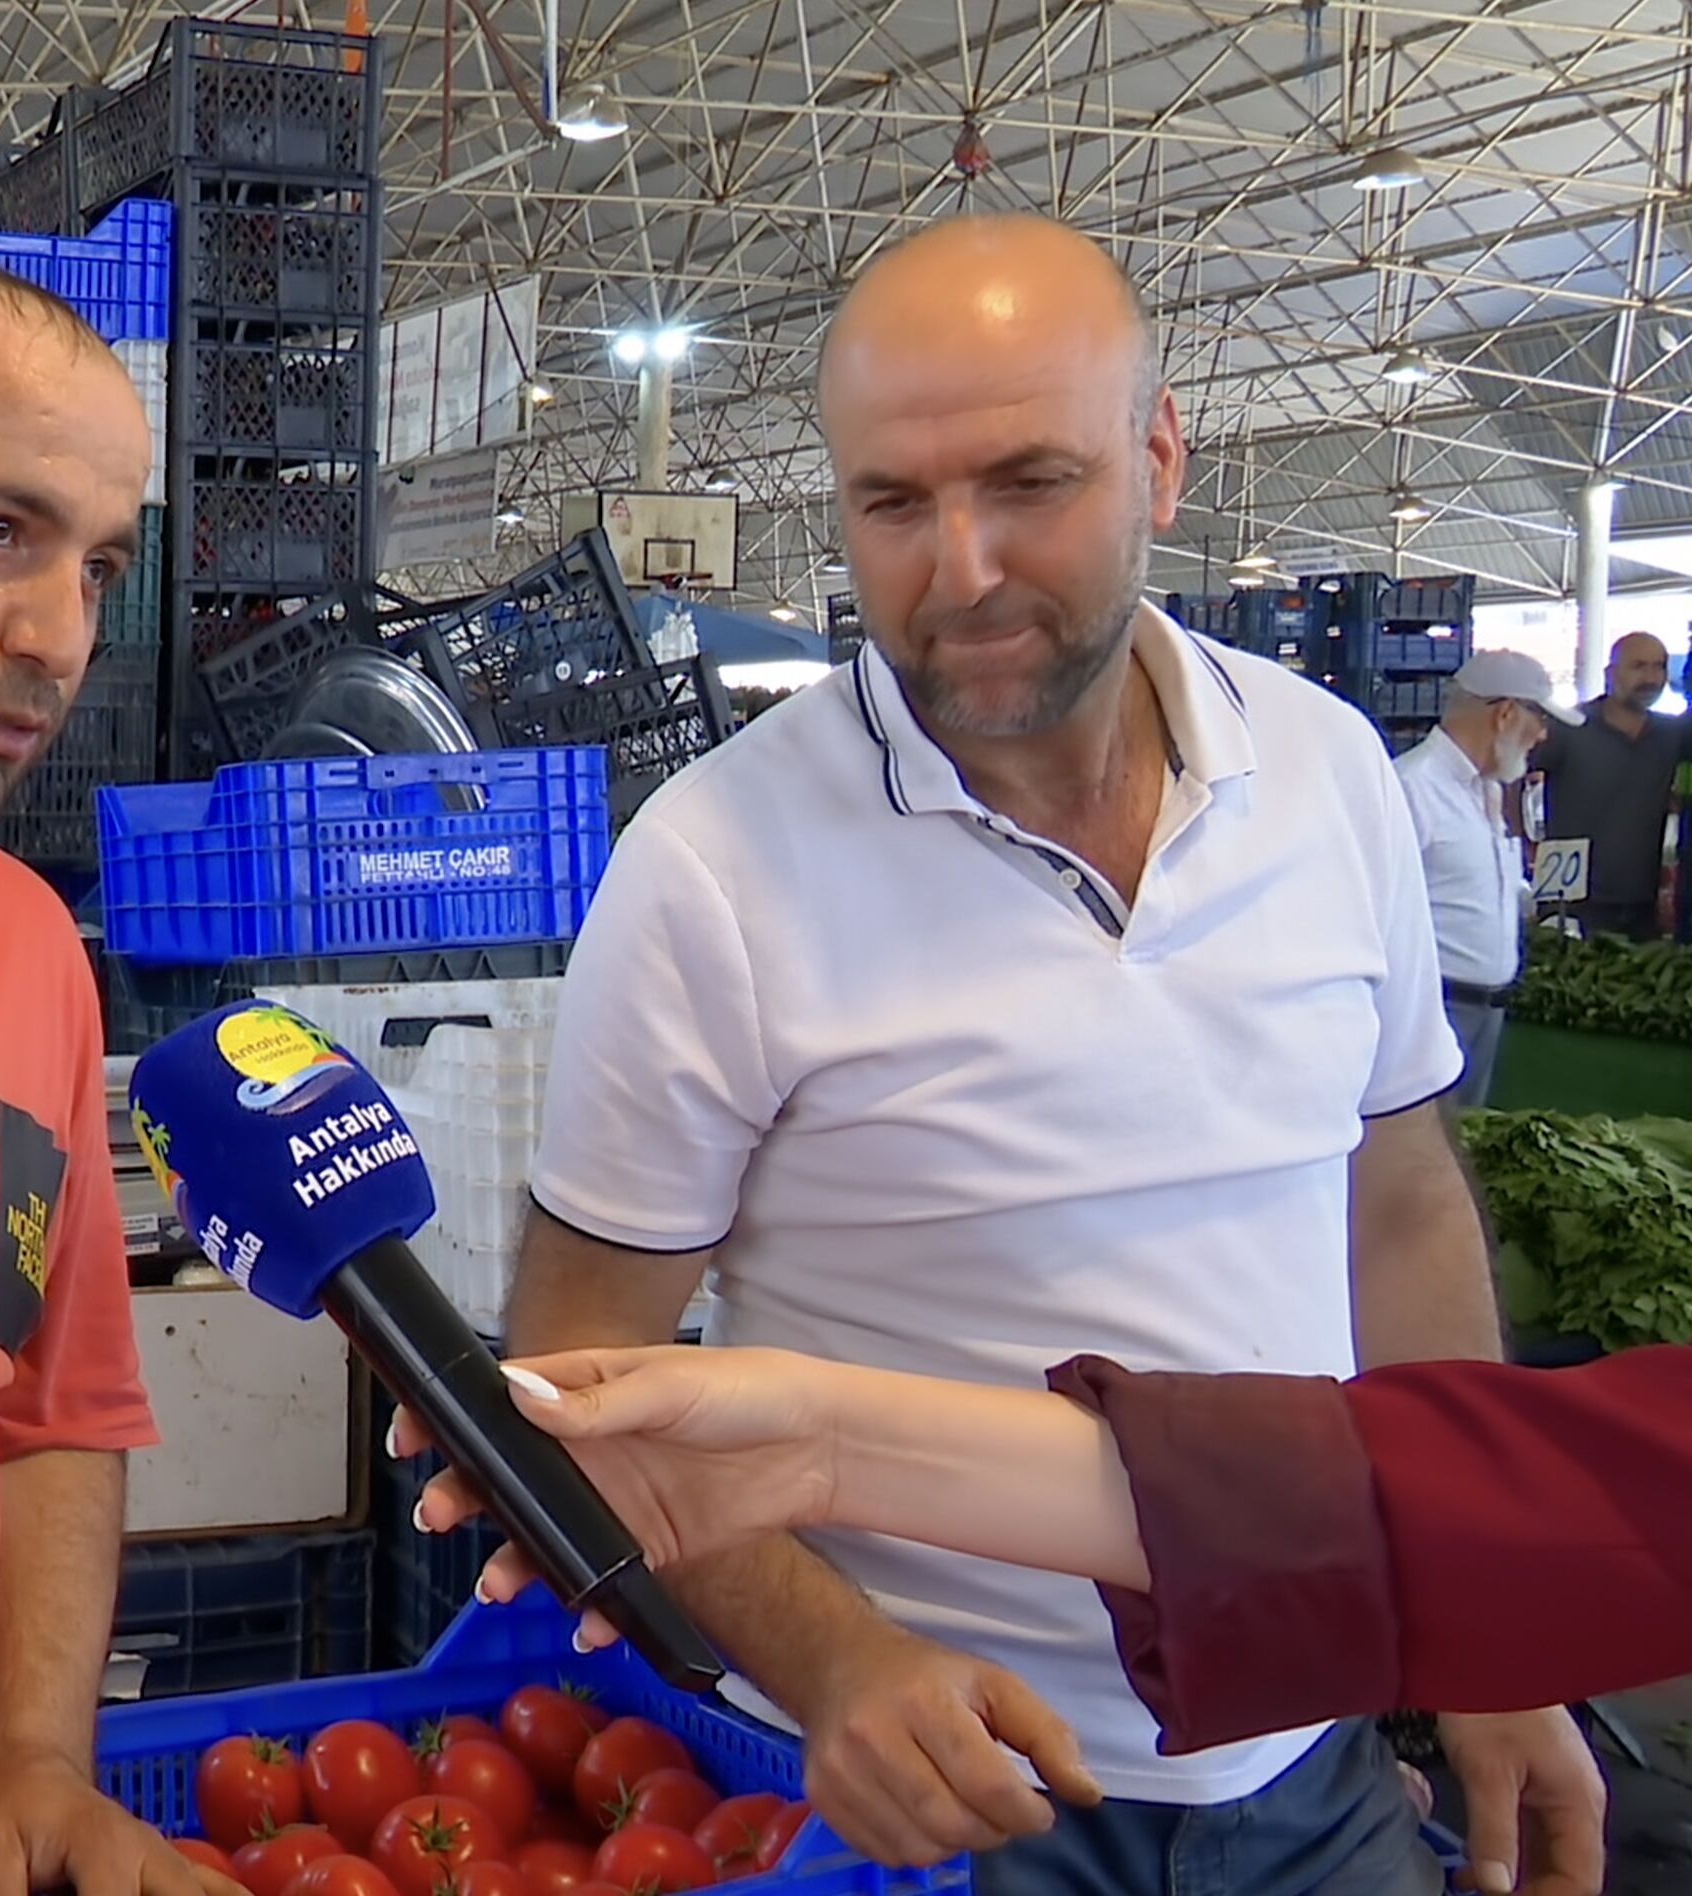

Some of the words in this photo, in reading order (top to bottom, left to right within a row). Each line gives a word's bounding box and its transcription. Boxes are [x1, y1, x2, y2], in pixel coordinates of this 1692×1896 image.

[360, 851, 444, 872] MEHMET
[448, 845, 511, 871] ÇAKIR
[1533, 850, 1582, 899] 20
[228, 1032, 292, 1063] Antalya
[288, 1101, 392, 1166] Antalya
[292, 1128, 418, 1208] Hakkında
